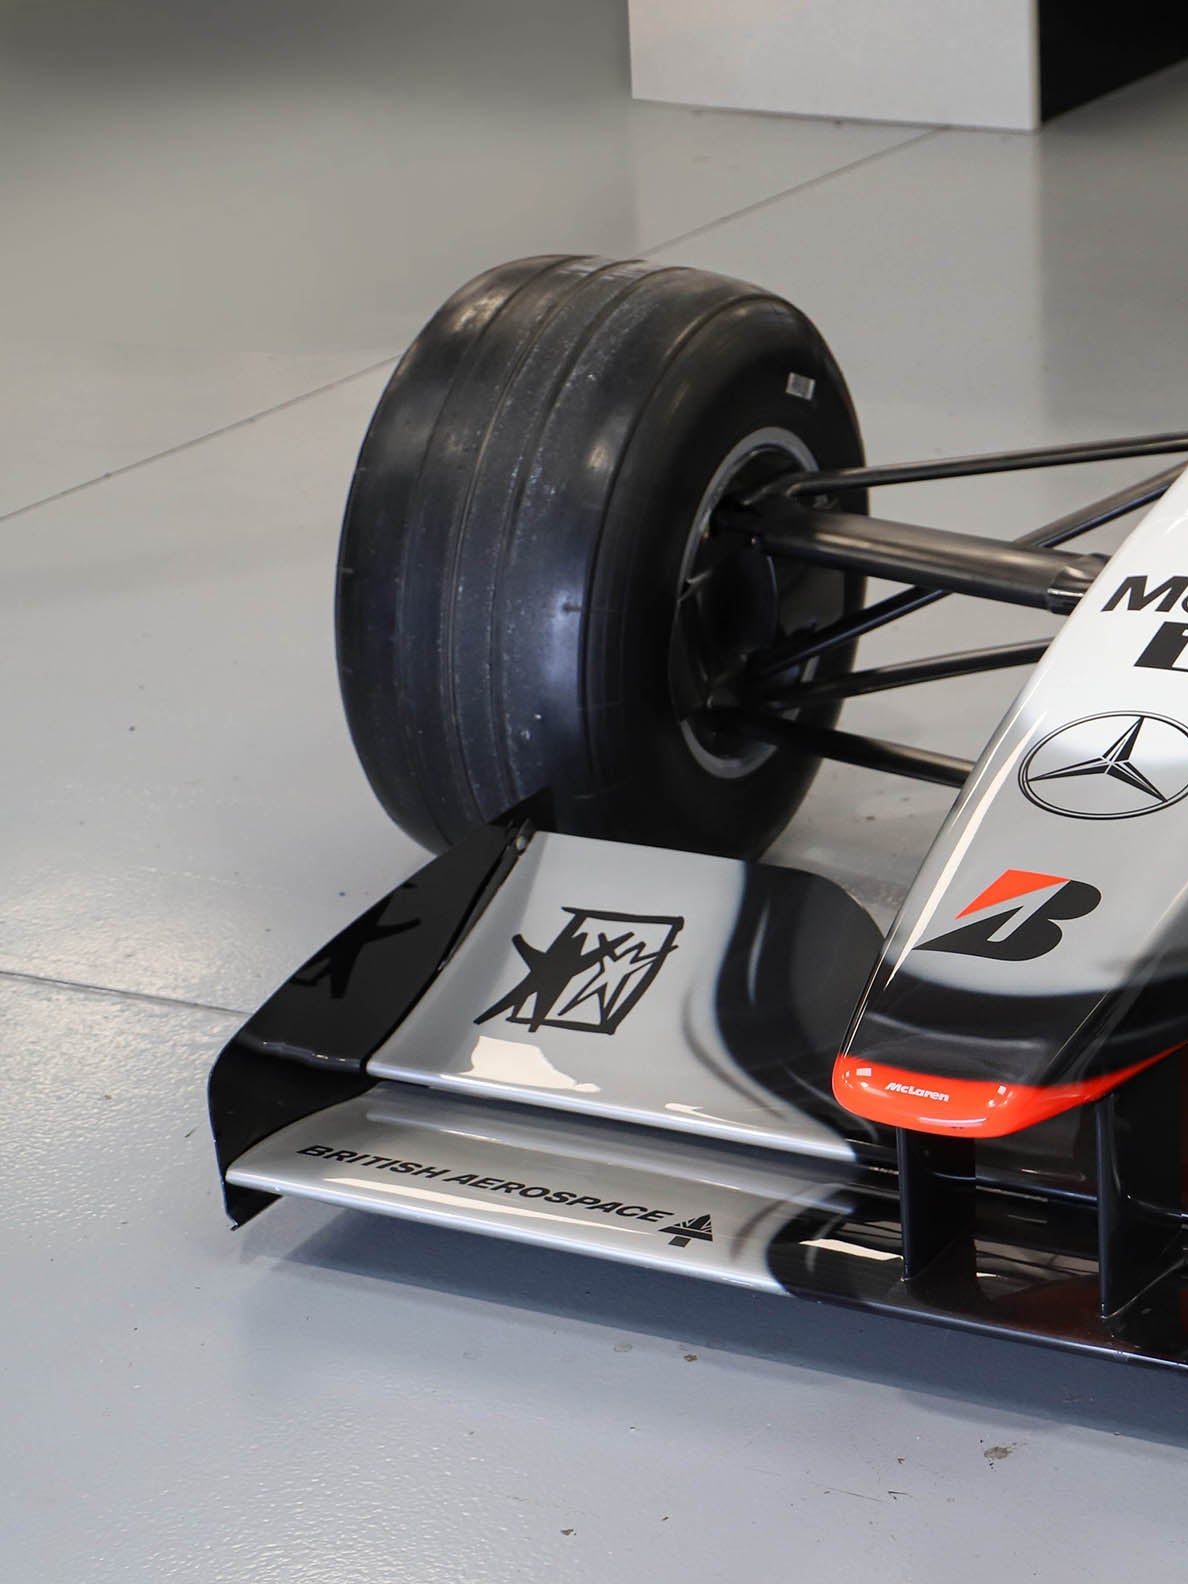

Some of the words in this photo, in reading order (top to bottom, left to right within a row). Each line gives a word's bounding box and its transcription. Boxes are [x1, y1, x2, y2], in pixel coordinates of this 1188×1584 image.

[885, 1081, 950, 1102] McLaren
[296, 1144, 451, 1179] BRITISH
[443, 1173, 674, 1223] AEROSPACE
